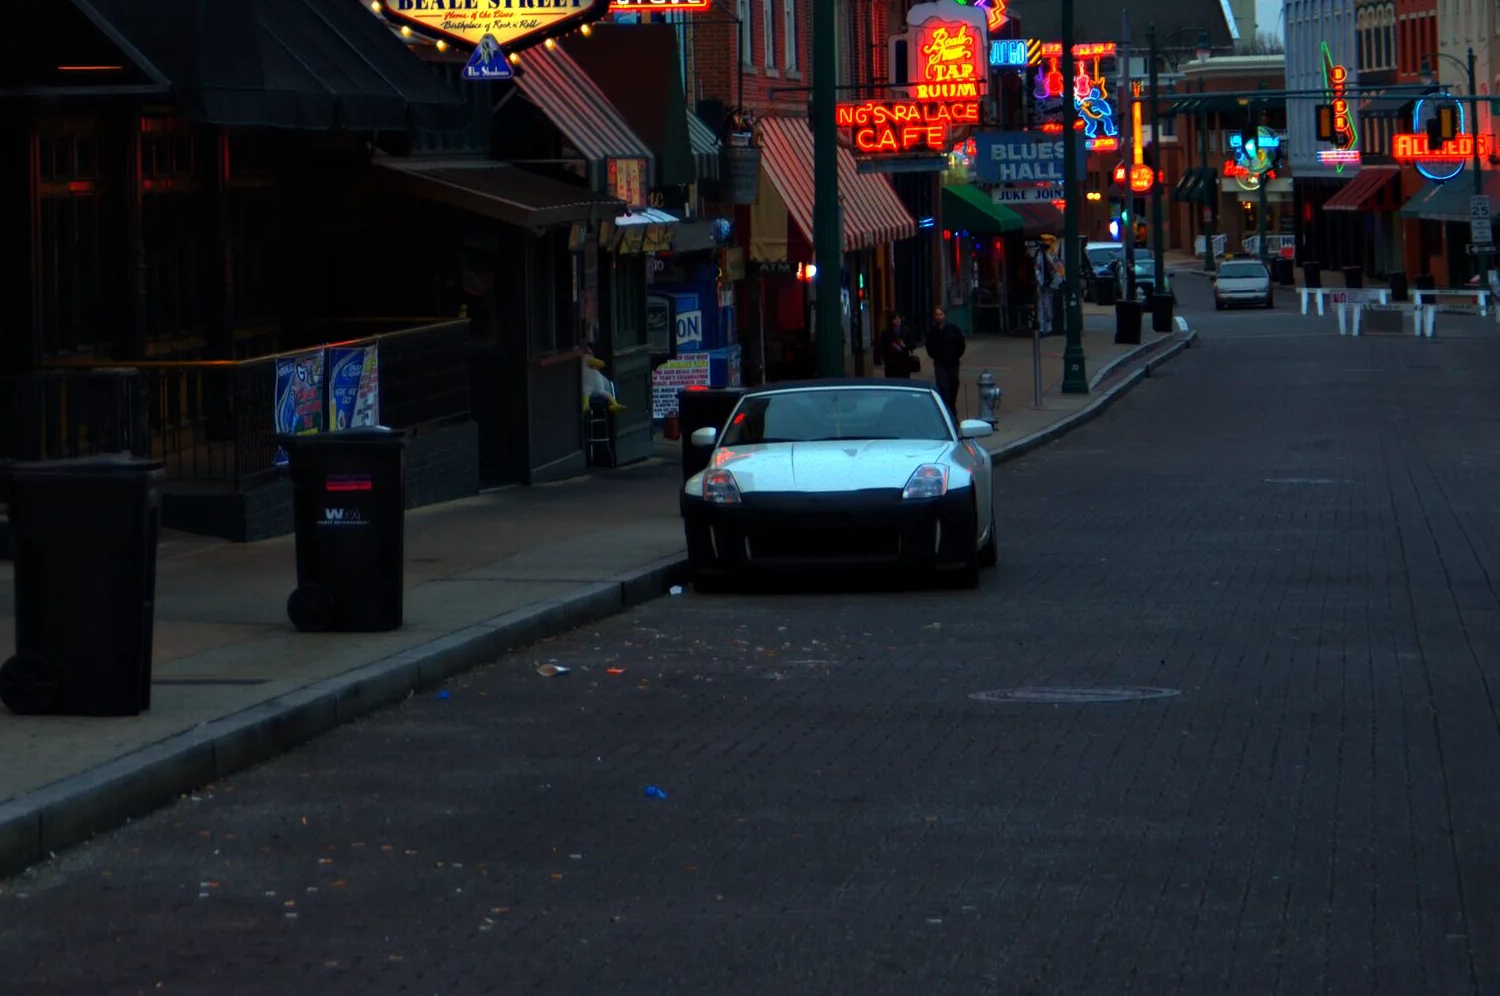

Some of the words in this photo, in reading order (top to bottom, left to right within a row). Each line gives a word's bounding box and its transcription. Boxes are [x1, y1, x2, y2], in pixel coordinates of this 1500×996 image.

[444, 11, 469, 20] Home
[479, 10, 492, 18] the
[493, 9, 514, 18] Blues
[442, 21, 482, 34] Birthplace
[493, 20, 511, 29] Rock
[519, 19, 540, 29] Roll
[933, 62, 974, 82] TAP
[858, 125, 943, 149] CAFE
[990, 141, 1065, 161] BLUES
[1000, 162, 1062, 182] HALL
[999, 189, 1027, 201] JUKE
[1035, 188, 1063, 200] JOIN
[1472, 206, 1489, 215] 25
[760, 263, 790, 273] ATM
